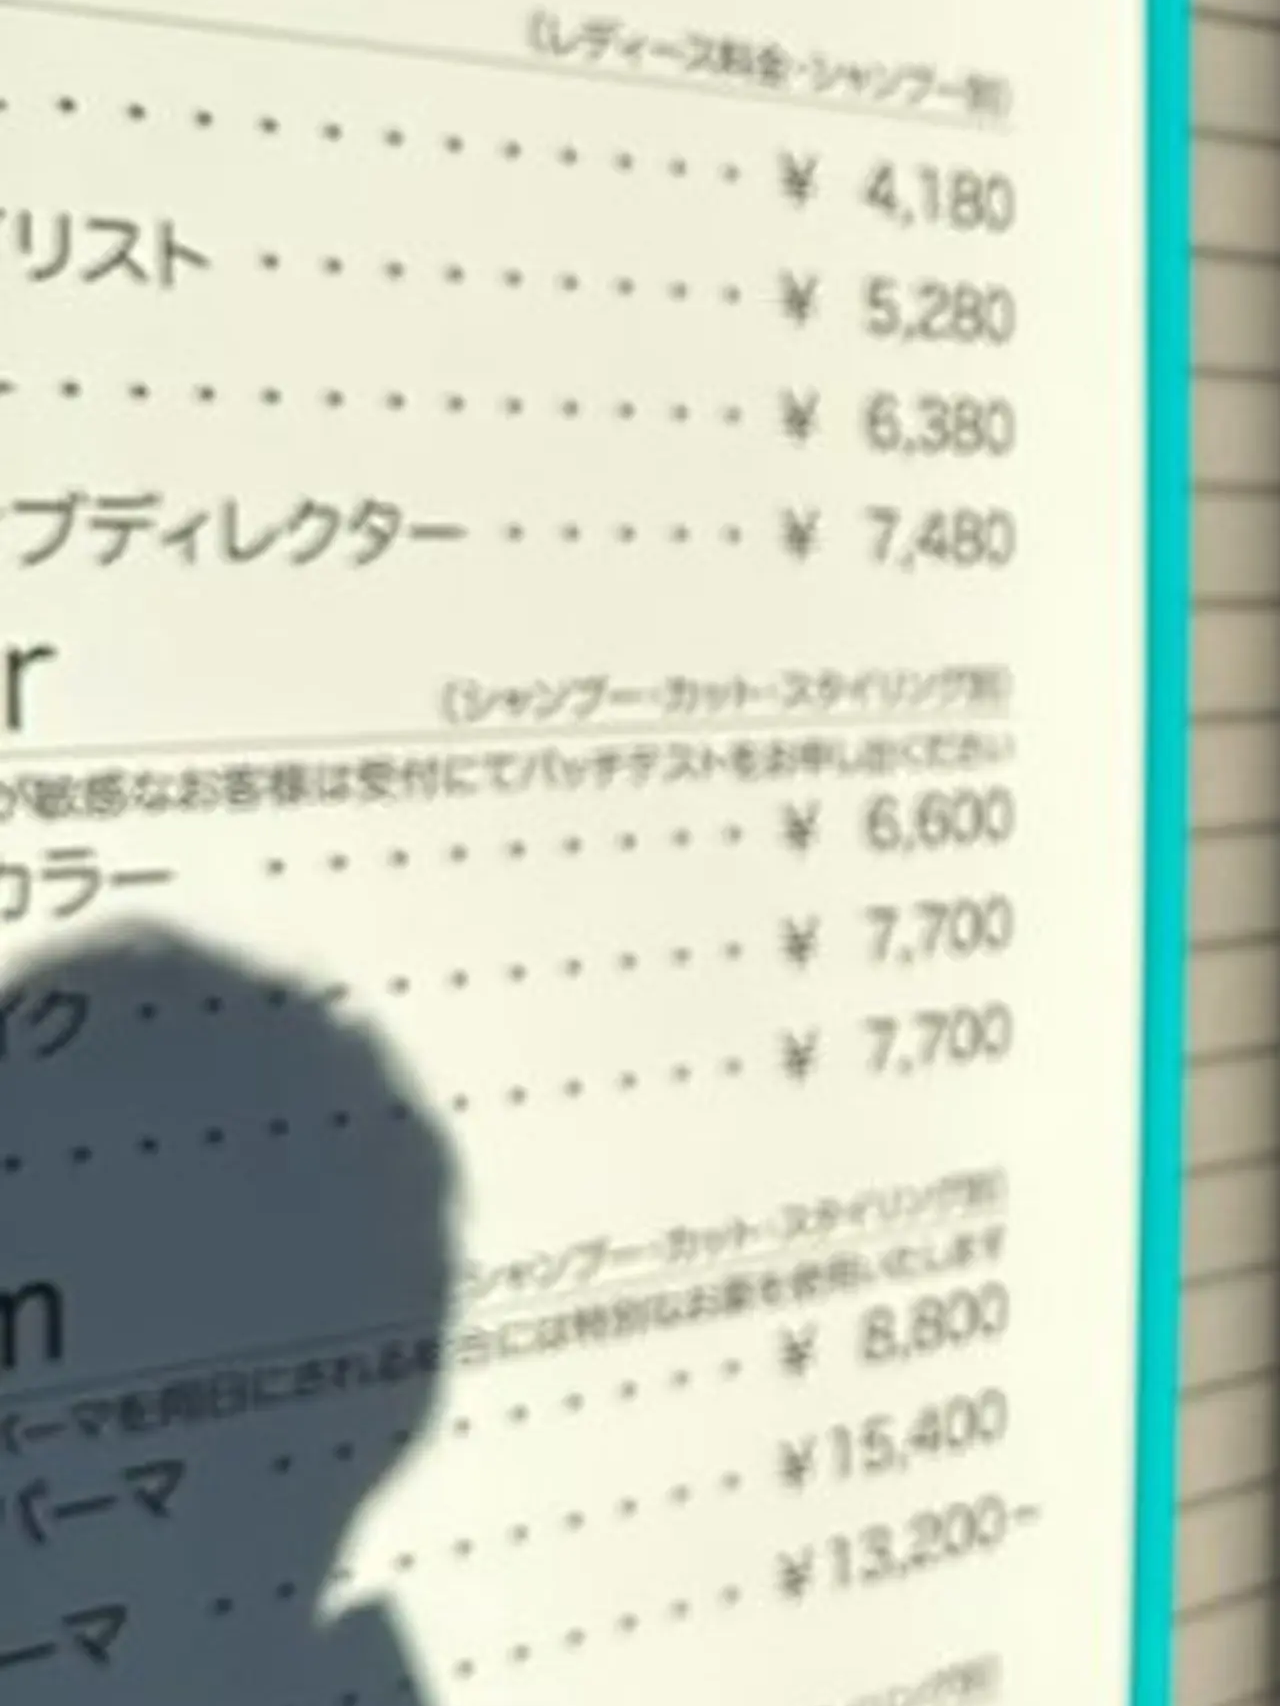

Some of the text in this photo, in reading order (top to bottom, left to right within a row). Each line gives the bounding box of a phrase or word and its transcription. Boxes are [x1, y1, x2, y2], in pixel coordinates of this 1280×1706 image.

[860, 161, 1015, 233] 4,180
[0, 207, 211, 289] リスト
[862, 275, 1015, 346] 5,280
[859, 390, 1015, 457] 6,380
[865, 505, 1016, 571] 7,480
[3, 645, 57, 732] r
[861, 786, 1014, 854] 6,600
[864, 894, 1014, 965] 7,700
[864, 1002, 1013, 1076] 7,700
[859, 1281, 1009, 1367] 8,800
